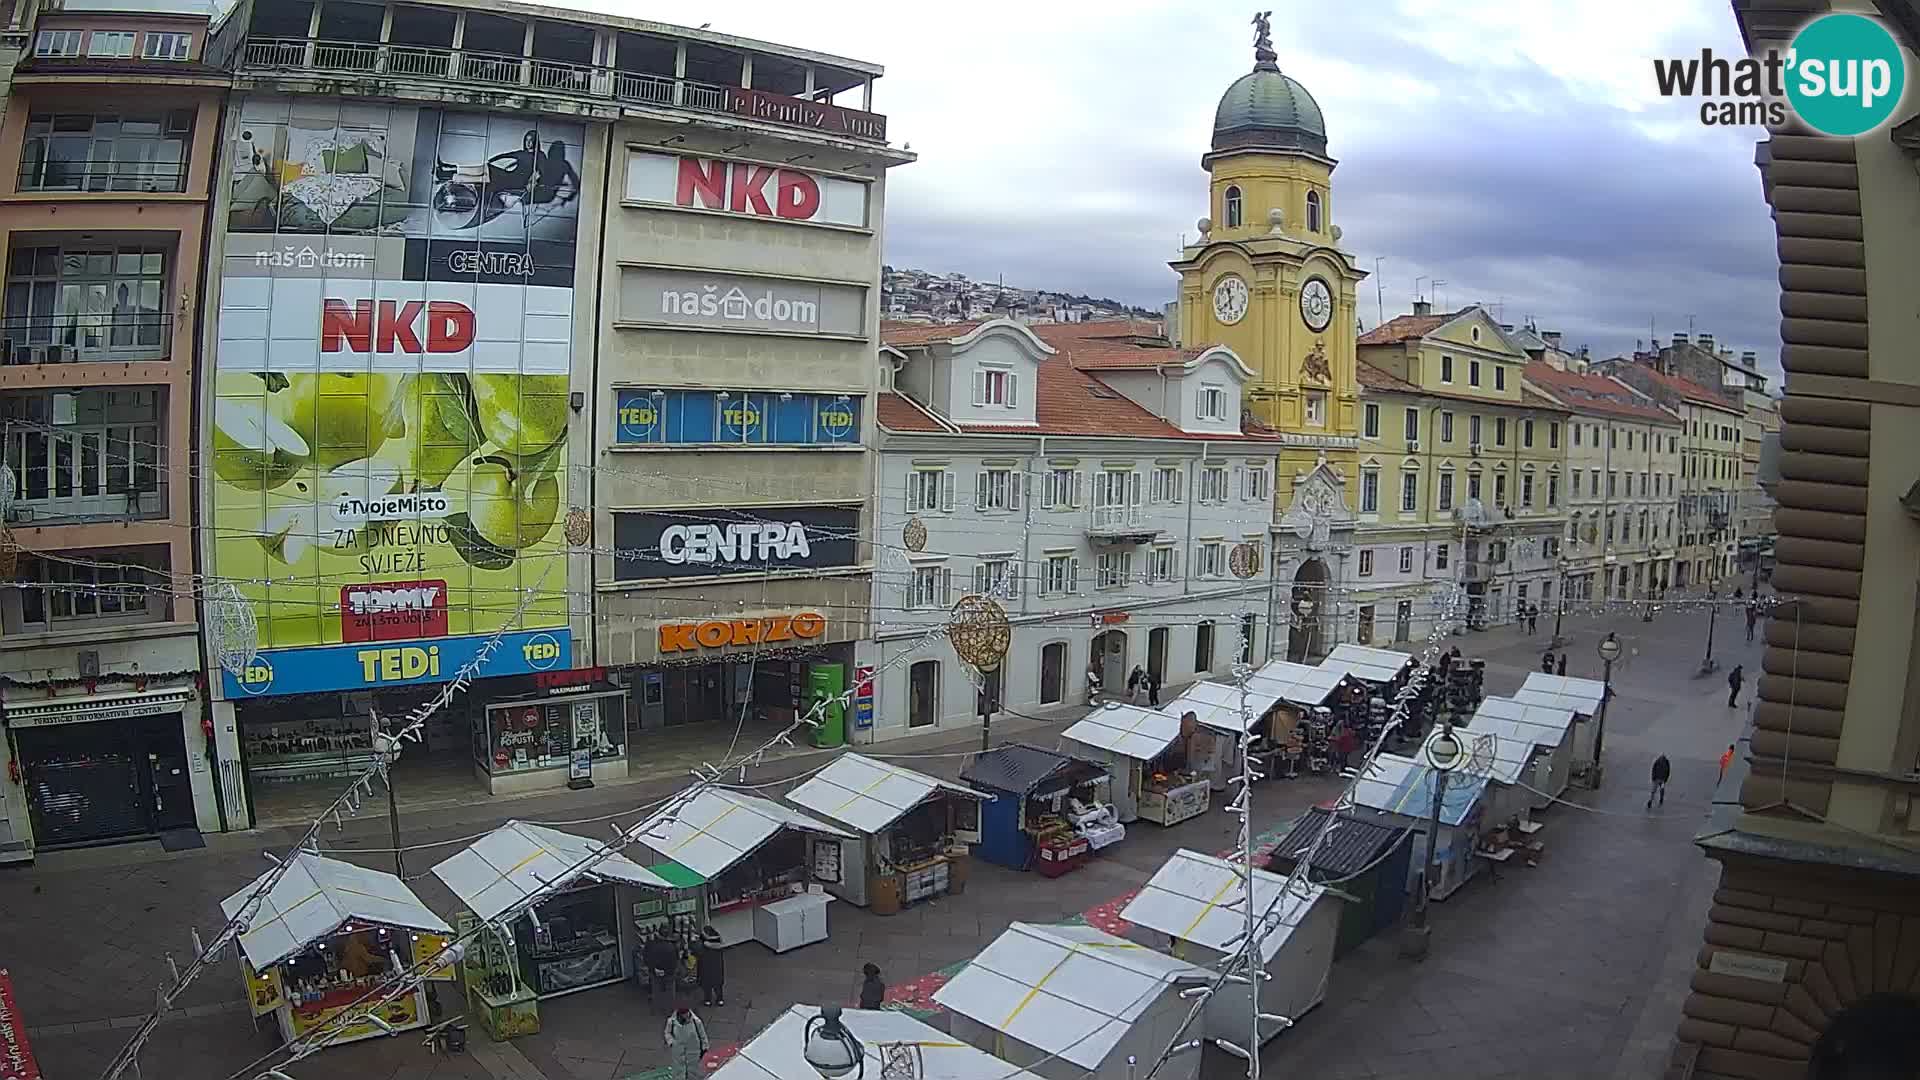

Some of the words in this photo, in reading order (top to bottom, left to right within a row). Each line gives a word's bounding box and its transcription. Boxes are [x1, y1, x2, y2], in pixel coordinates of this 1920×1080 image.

[723, 89, 745, 112] Le
[751, 95, 825, 127] Rendez
[841, 110, 883, 137] Vous
[676, 158, 820, 219] NKD
[254, 246, 295, 269] naš
[320, 247, 366, 269] dom
[448, 249, 536, 277] CENTRA
[661, 284, 719, 317] naš
[753, 290, 817, 324] dom
[321, 298, 477, 355] NKD
[619, 408, 658, 426] TEDi
[724, 409, 760, 426] TEDi
[820, 410, 853, 427] TEDi
[338, 496, 447, 517] #TvojeMisto
[333, 529, 358, 549] ZA
[368, 523, 451, 549] DNEVNO
[660, 521, 811, 565] CENTRA
[359, 547, 427, 576] SVJEŽE
[348, 587, 440, 615] TOMMY
[660, 612, 827, 653] KORZO
[357, 646, 441, 682] TEDi
[523, 643, 560, 660] TEDi
